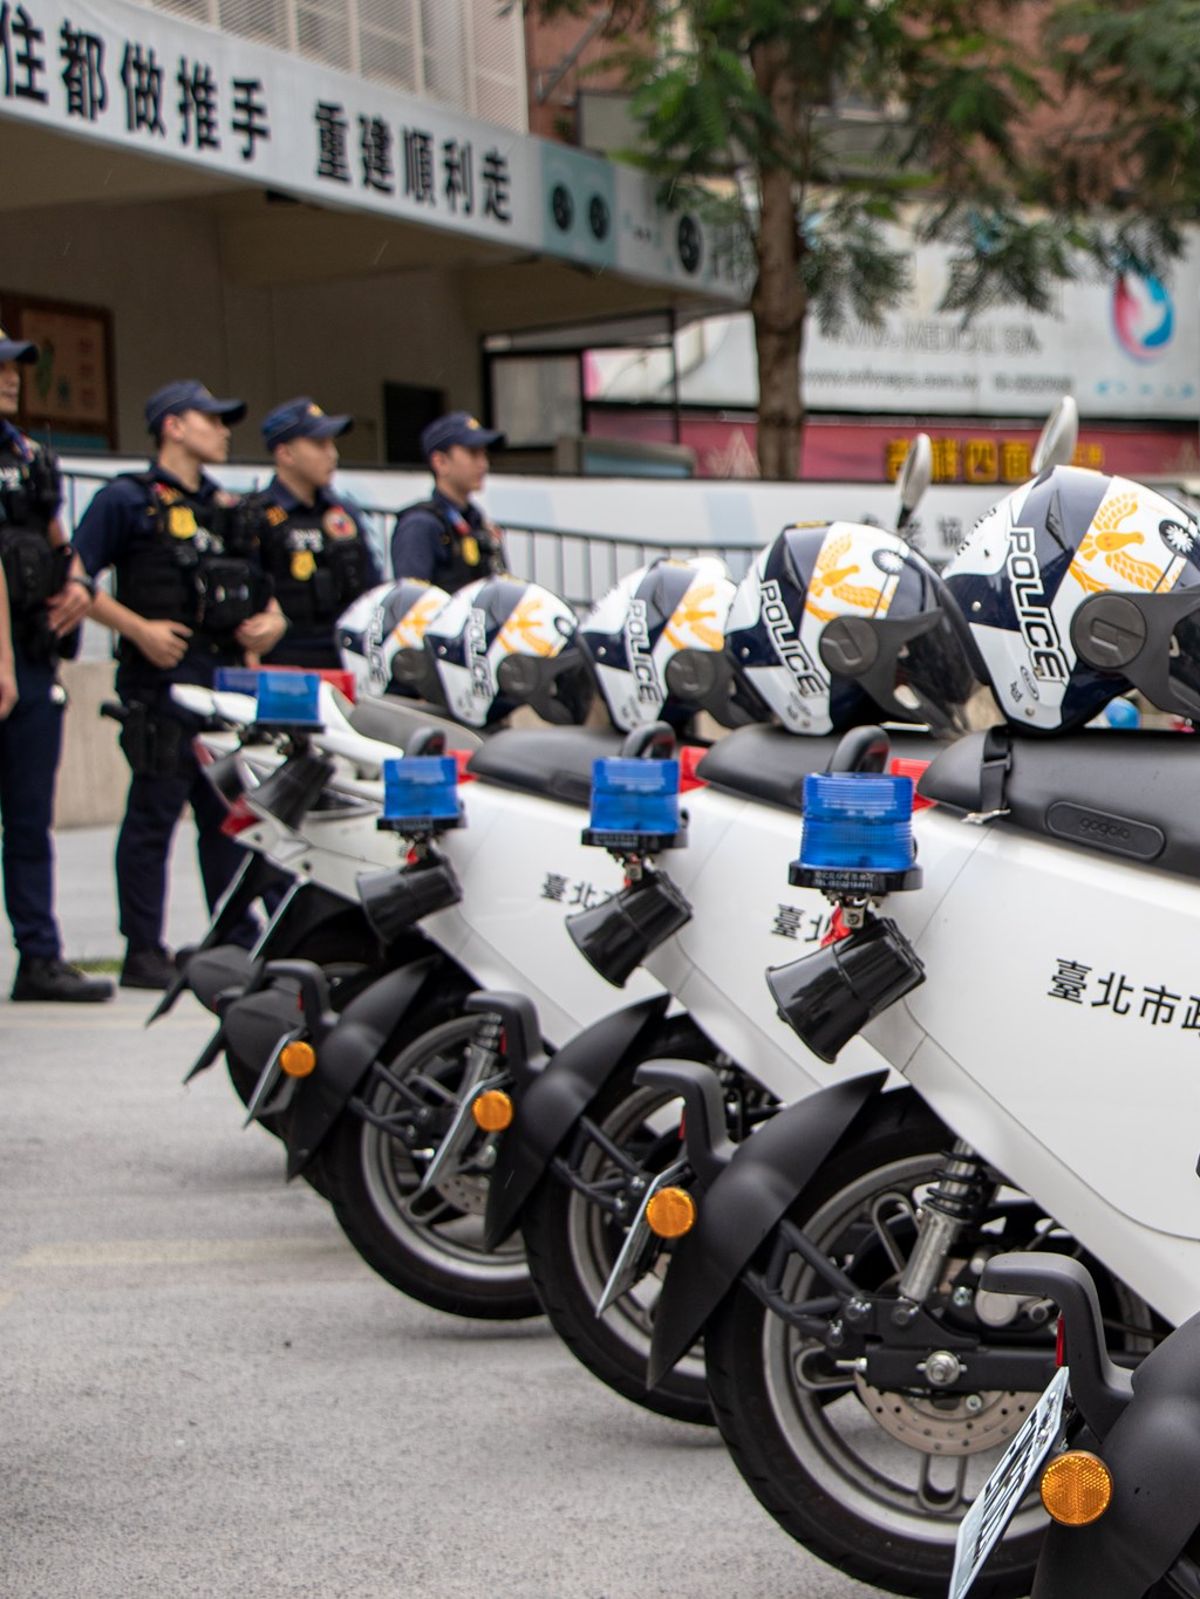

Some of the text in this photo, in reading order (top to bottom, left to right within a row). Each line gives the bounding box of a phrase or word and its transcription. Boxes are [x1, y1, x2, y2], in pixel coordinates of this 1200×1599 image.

[314, 99, 513, 225] 重建順利走
[467, 608, 493, 699] POLICE
[628, 600, 664, 705] POLICE
[760, 578, 826, 697] POLICE
[1006, 527, 1068, 682] POLICE
[1079, 817, 1131, 840] gogoro
